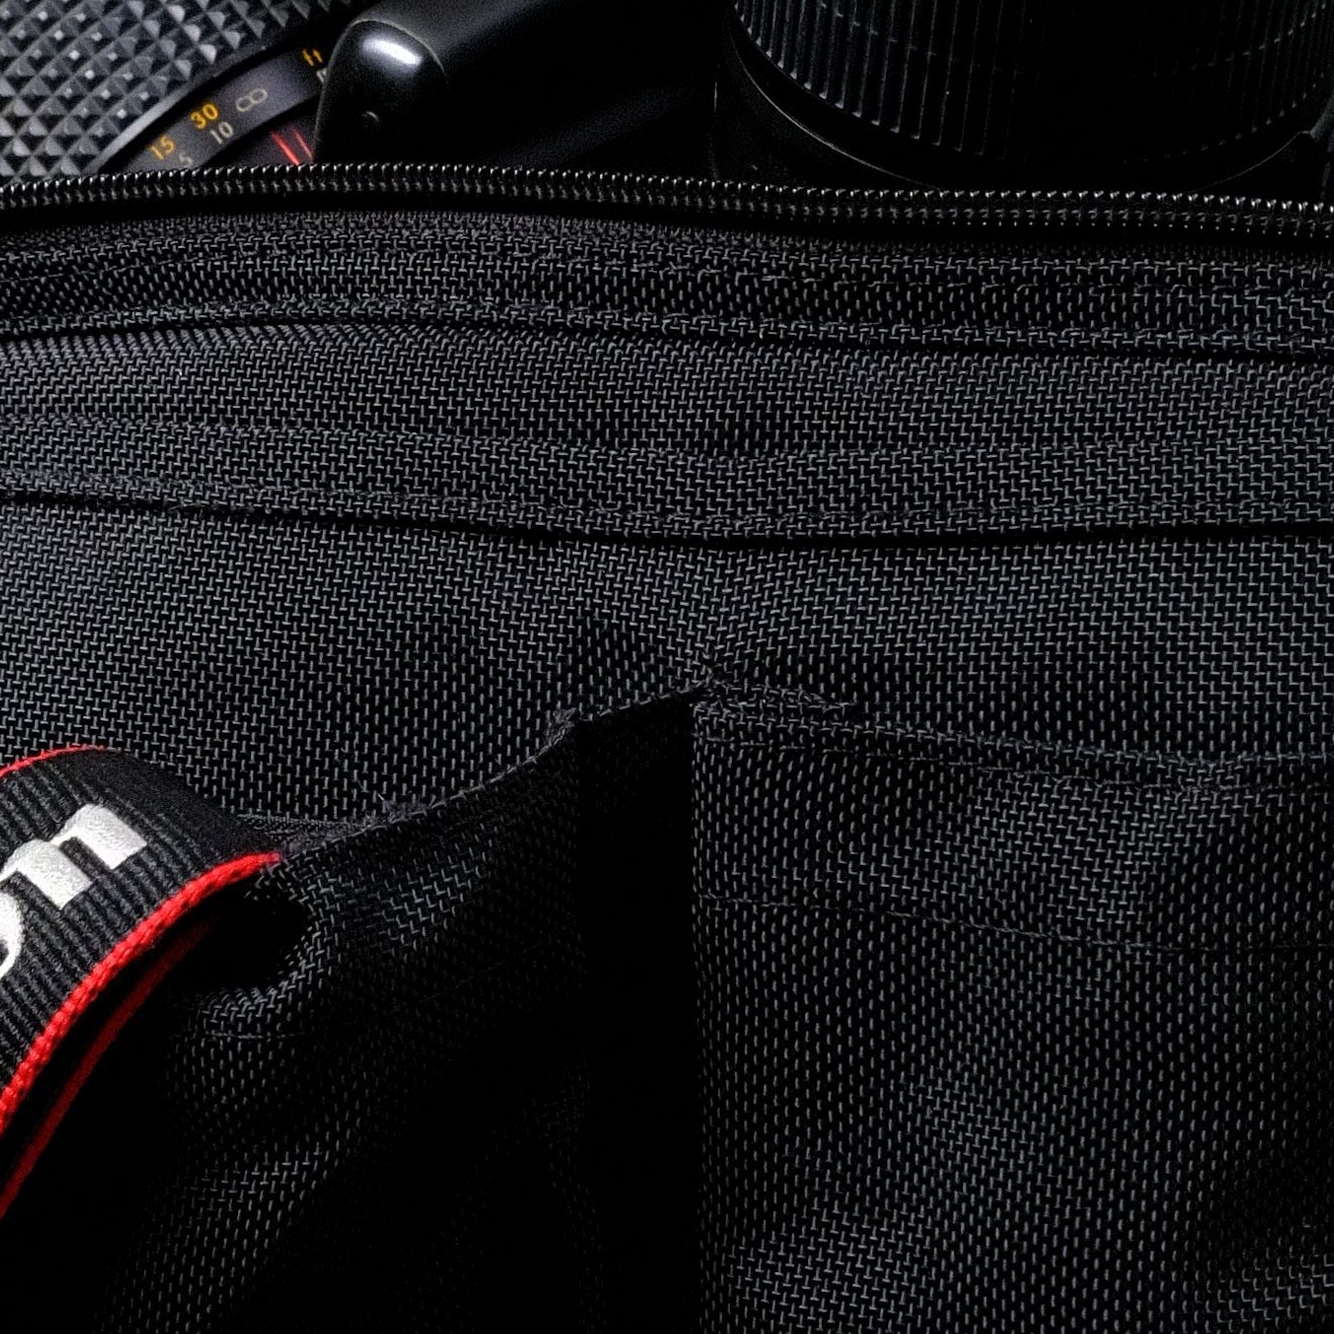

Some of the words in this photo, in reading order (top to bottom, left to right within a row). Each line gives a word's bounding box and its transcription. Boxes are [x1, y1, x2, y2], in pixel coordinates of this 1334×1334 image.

[148, 132, 176, 161] 15
[190, 103, 219, 131] 30
[209, 120, 234, 145] 10
